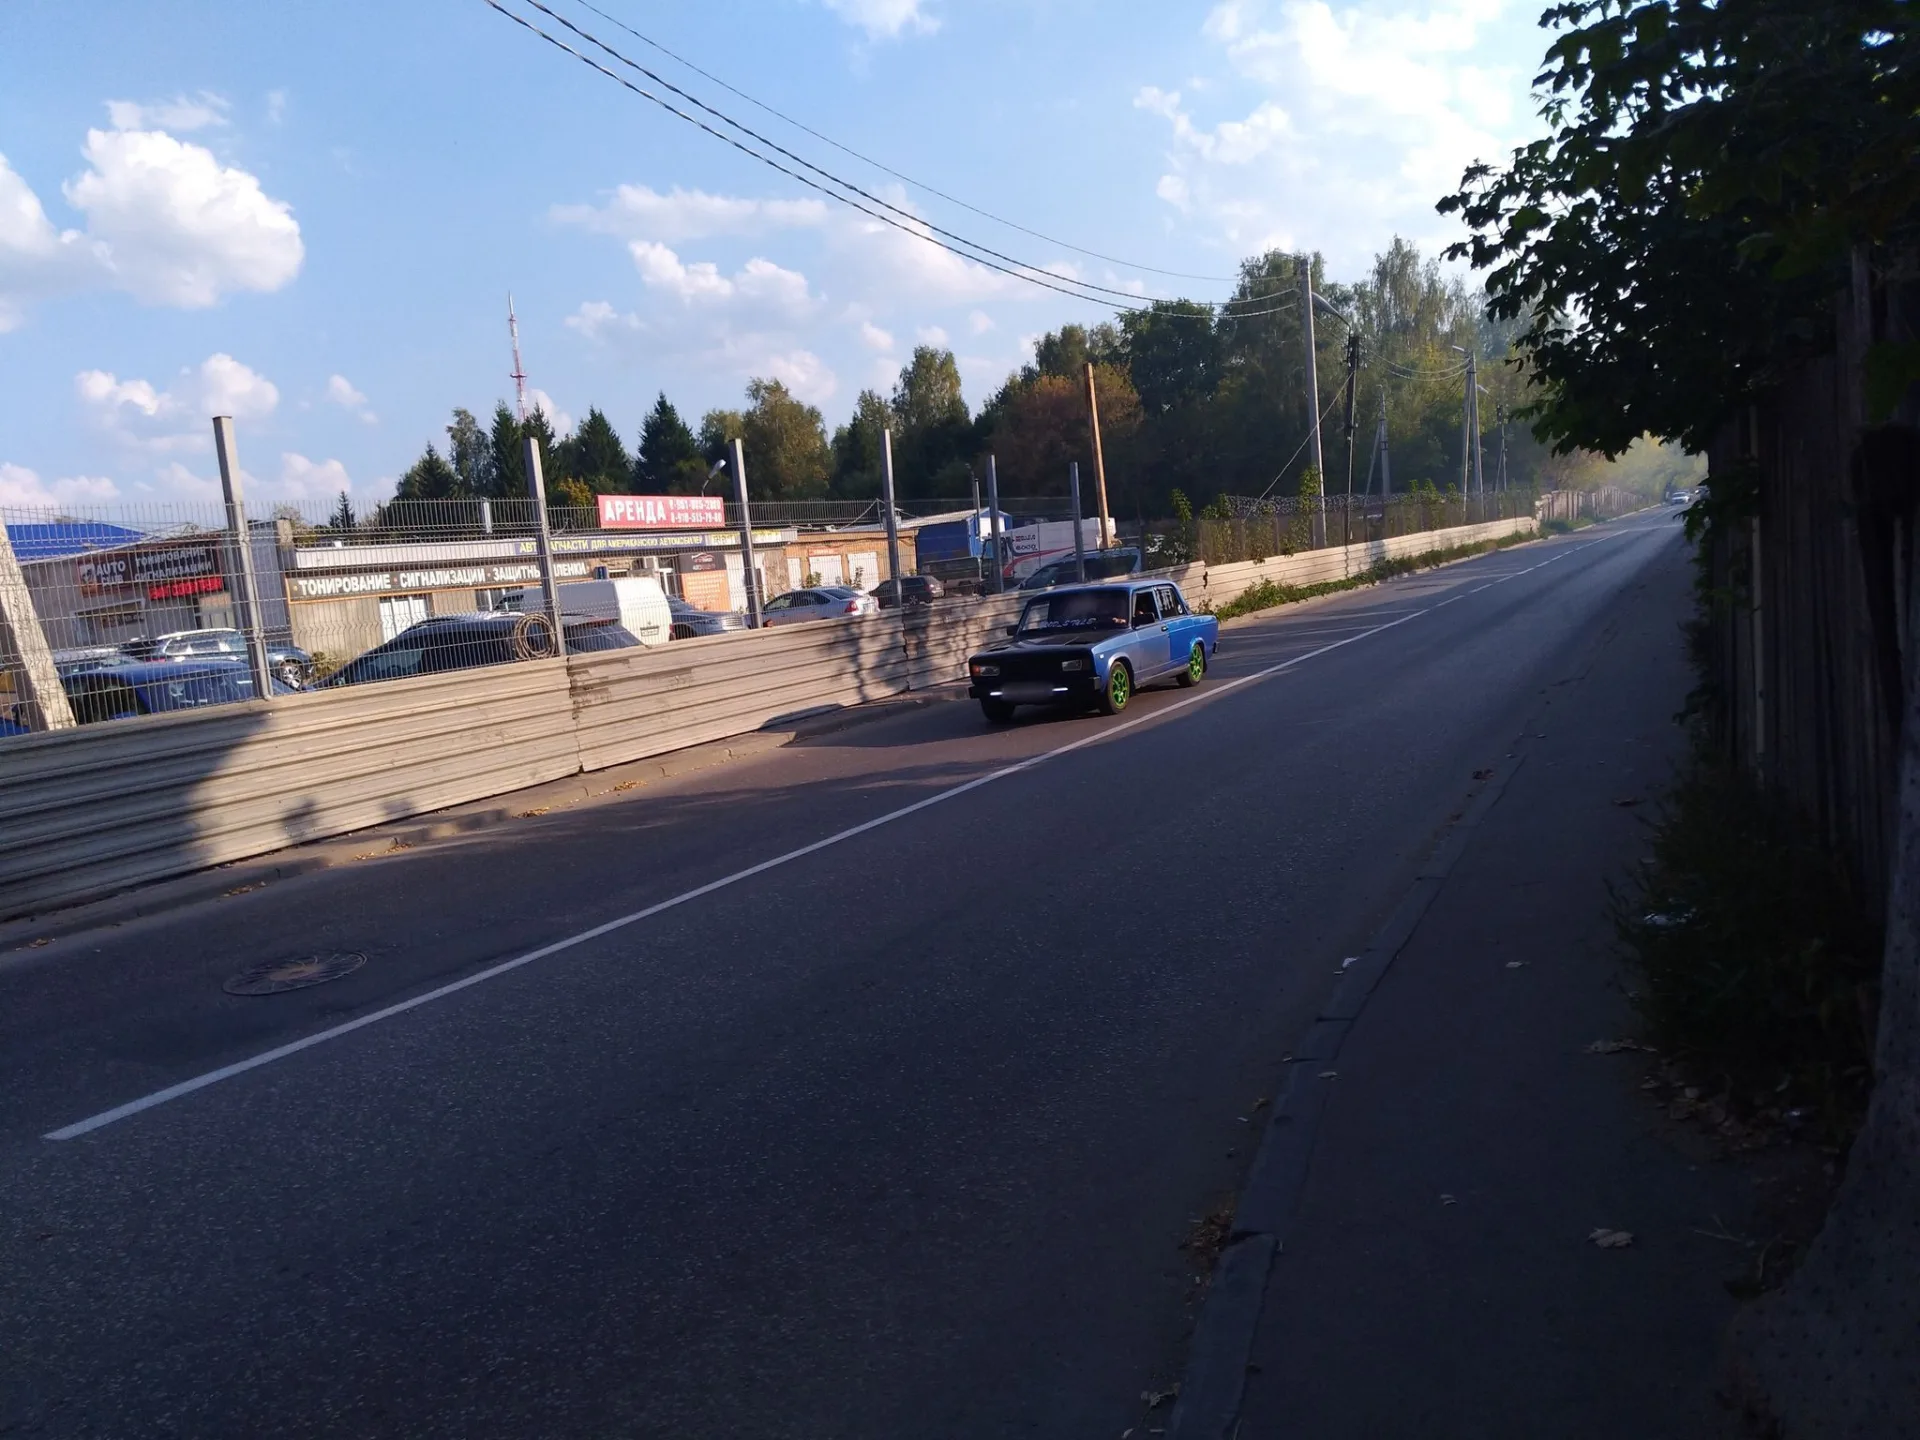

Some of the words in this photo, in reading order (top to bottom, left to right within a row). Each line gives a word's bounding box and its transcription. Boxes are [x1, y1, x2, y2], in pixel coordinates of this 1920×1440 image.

[604, 499, 667, 524] АРЕНДА
[591, 539, 607, 551] ДЛЯ
[134, 546, 207, 567] ТОНИРОВАНИЕ
[95, 560, 126, 576] AUTO
[298, 573, 392, 597] ТОНИРОВАНИЕ
[399, 567, 486, 589] СИГНАЛИЗАЦИИ
[492, 564, 541, 582] ЗАЩИТНЫ
[553, 561, 587, 577] ЛЕНКИ
